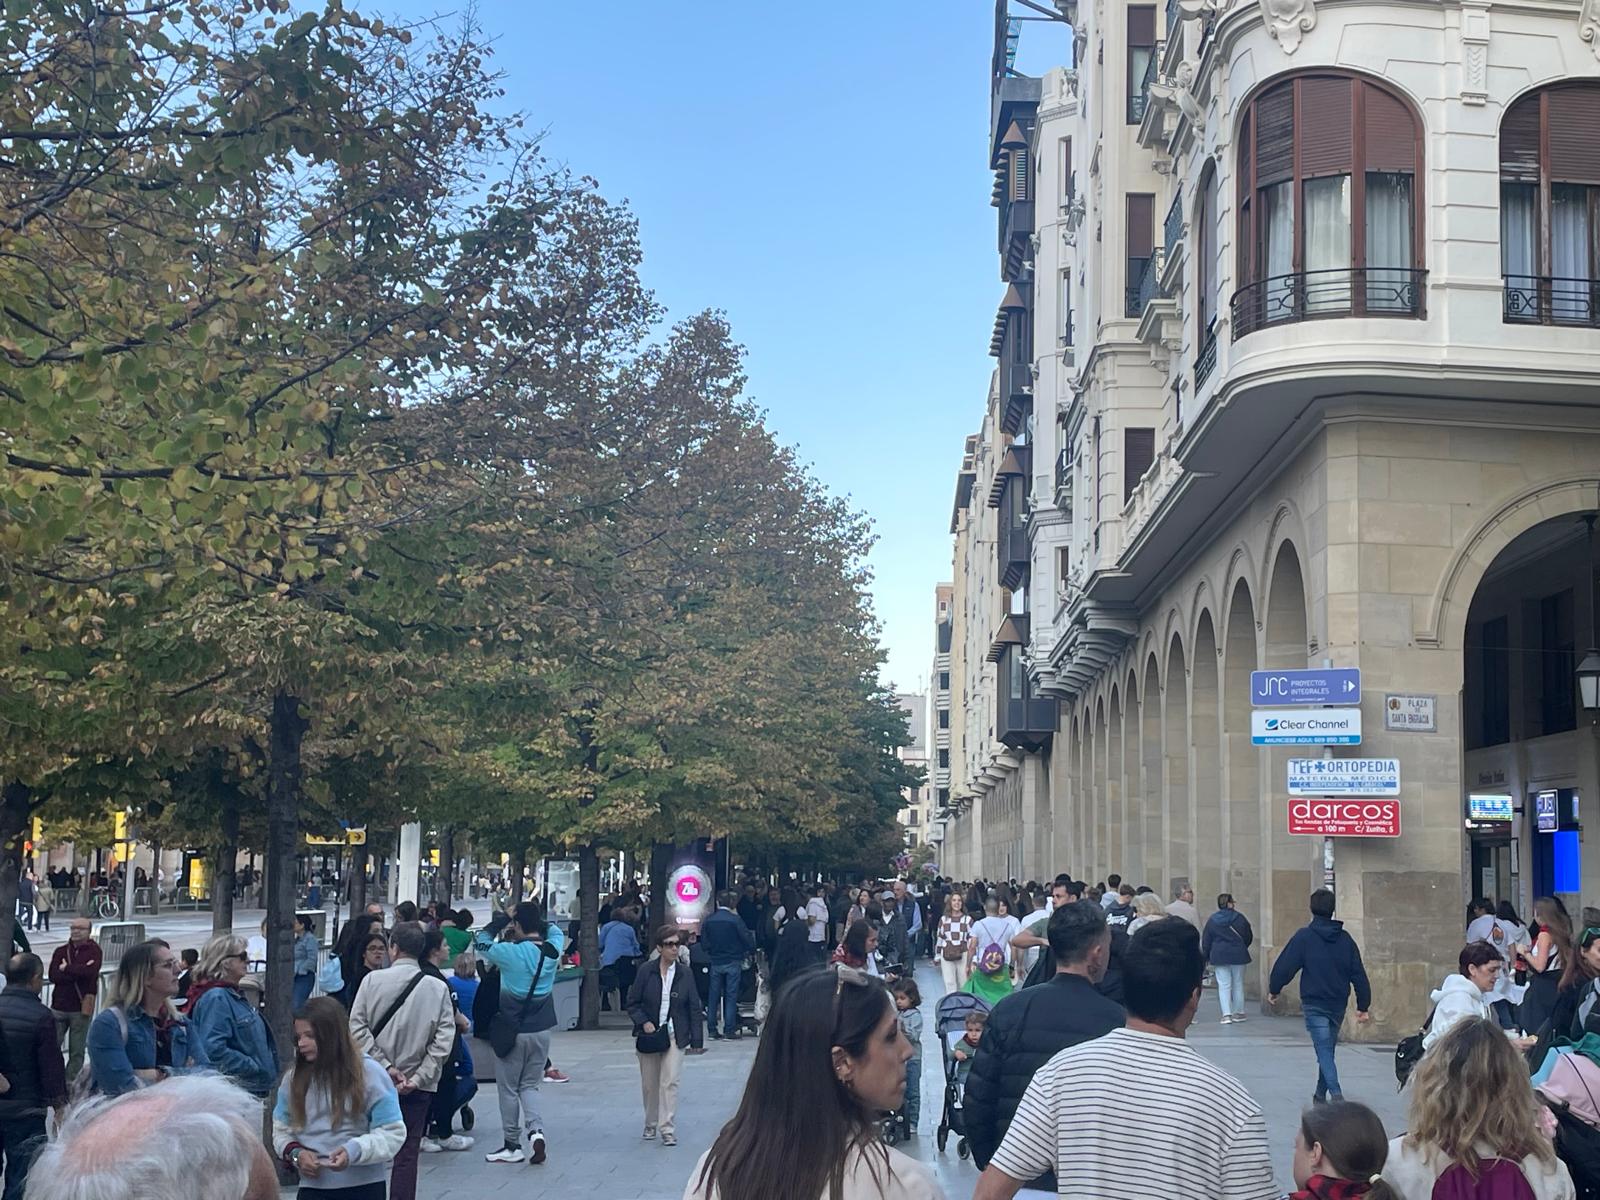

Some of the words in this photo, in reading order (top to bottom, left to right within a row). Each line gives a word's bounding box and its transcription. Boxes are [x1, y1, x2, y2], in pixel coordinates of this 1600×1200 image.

[1291, 687, 1330, 695] INTEGRALES
[1408, 699, 1427, 707] PLAZA
[1392, 713, 1406, 722] SANTA
[1280, 720, 1306, 730] Clear
[1308, 719, 1349, 729] Channel
[1289, 760, 1313, 774] TEF
[1327, 761, 1396, 773] ORTOPEDIA
[1293, 800, 1394, 820] darcos
[1354, 826, 1364, 834] C/
